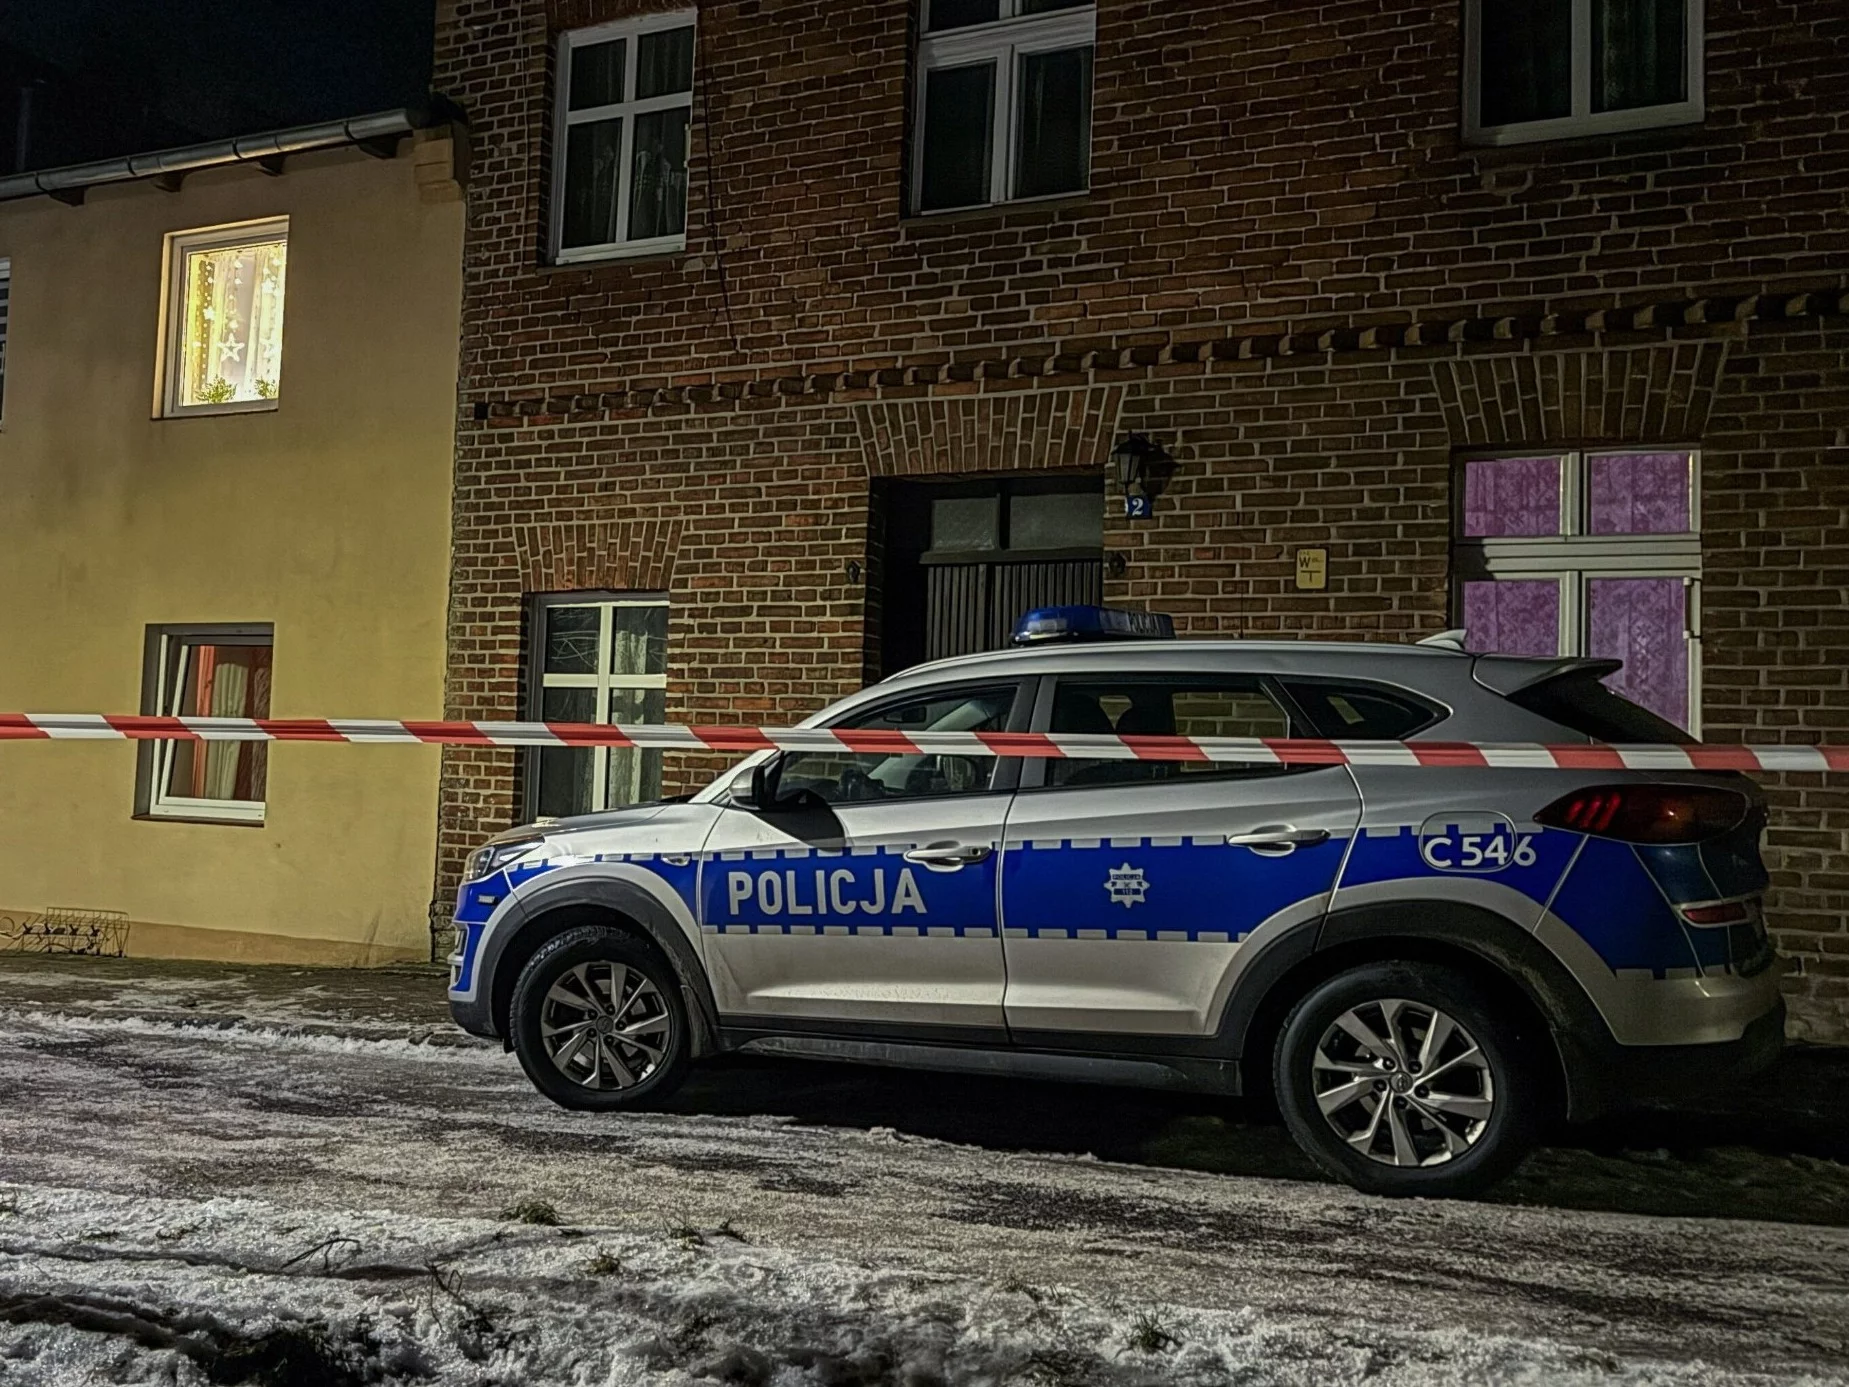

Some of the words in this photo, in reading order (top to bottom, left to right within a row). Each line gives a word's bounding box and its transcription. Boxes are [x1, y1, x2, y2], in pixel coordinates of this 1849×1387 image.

[1132, 497, 1144, 516] 2
[1299, 556, 1311, 568] W
[1424, 837, 1452, 868] C
[1461, 835, 1537, 867] 546
[728, 868, 927, 915] POLICJA
